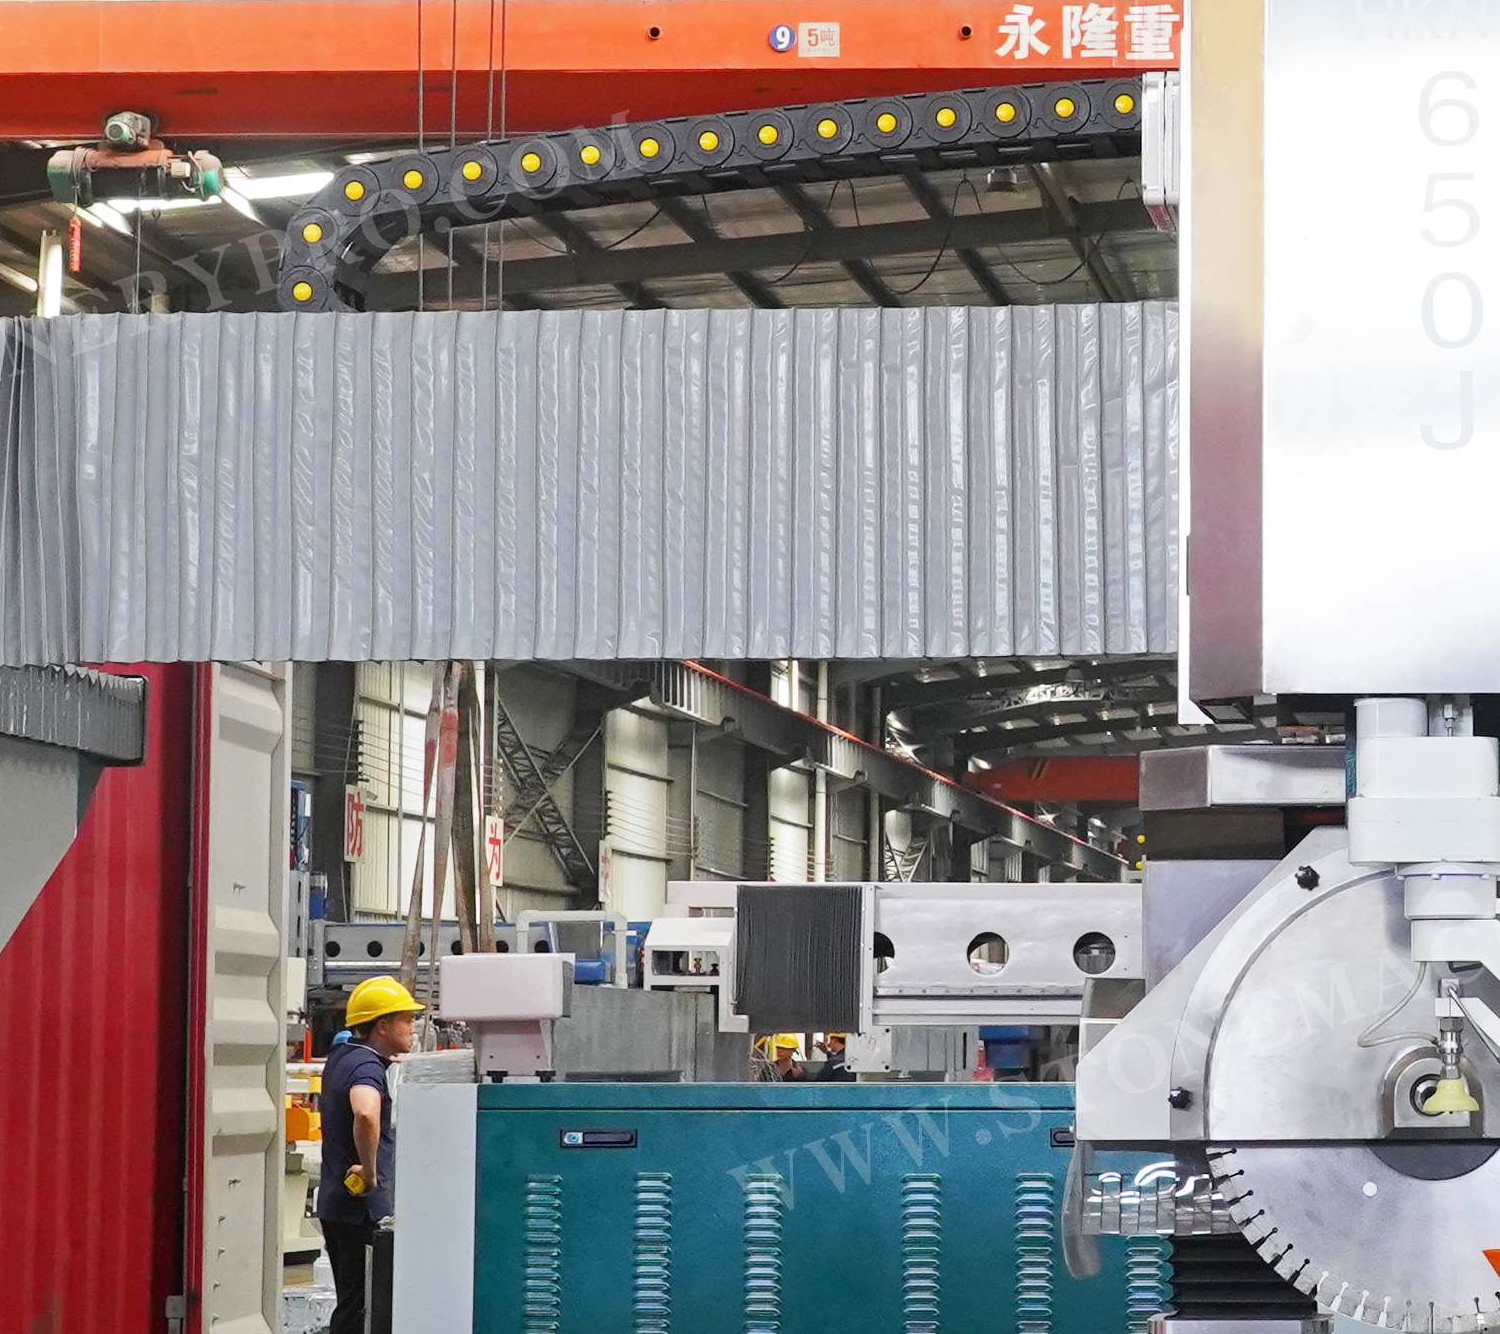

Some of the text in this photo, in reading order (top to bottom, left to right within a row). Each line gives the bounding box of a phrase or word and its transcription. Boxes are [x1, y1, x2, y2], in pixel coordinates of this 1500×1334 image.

[776, 27, 789, 50] 9
[995, 2, 1180, 60] 永隆重
[1418, 69, 1483, 451] 650J
[346, 790, 365, 859] 防
